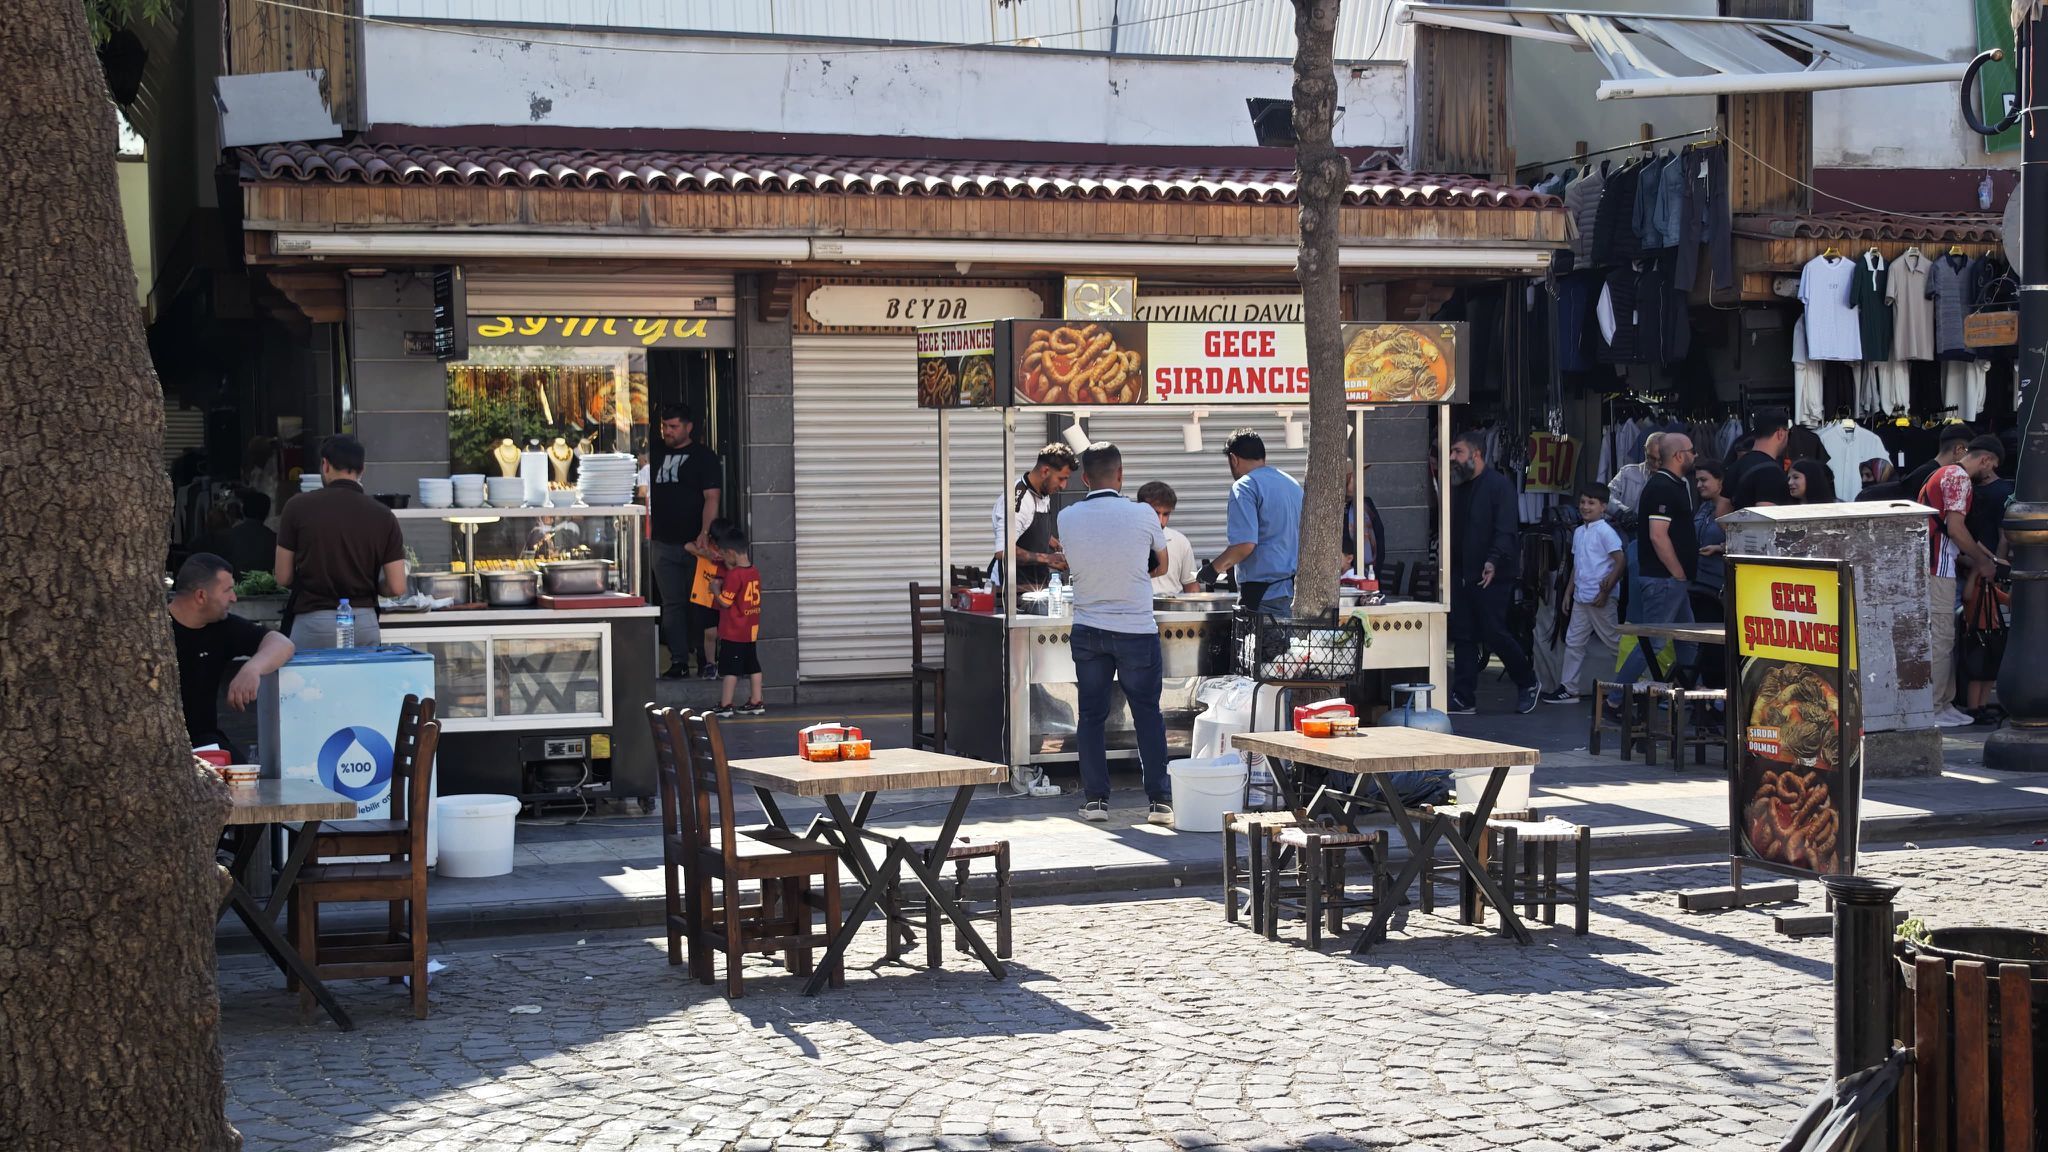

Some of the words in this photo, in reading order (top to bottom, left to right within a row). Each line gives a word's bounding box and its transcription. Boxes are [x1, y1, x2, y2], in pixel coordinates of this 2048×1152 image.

[886, 297, 967, 319] BEYDA
[1244, 304, 1304, 322] DAVU
[917, 331, 940, 352] GECE
[1204, 330, 1276, 357] GECE
[743, 580, 761, 606] 45
[1770, 581, 1818, 615] GECE
[340, 761, 372, 774] %100
